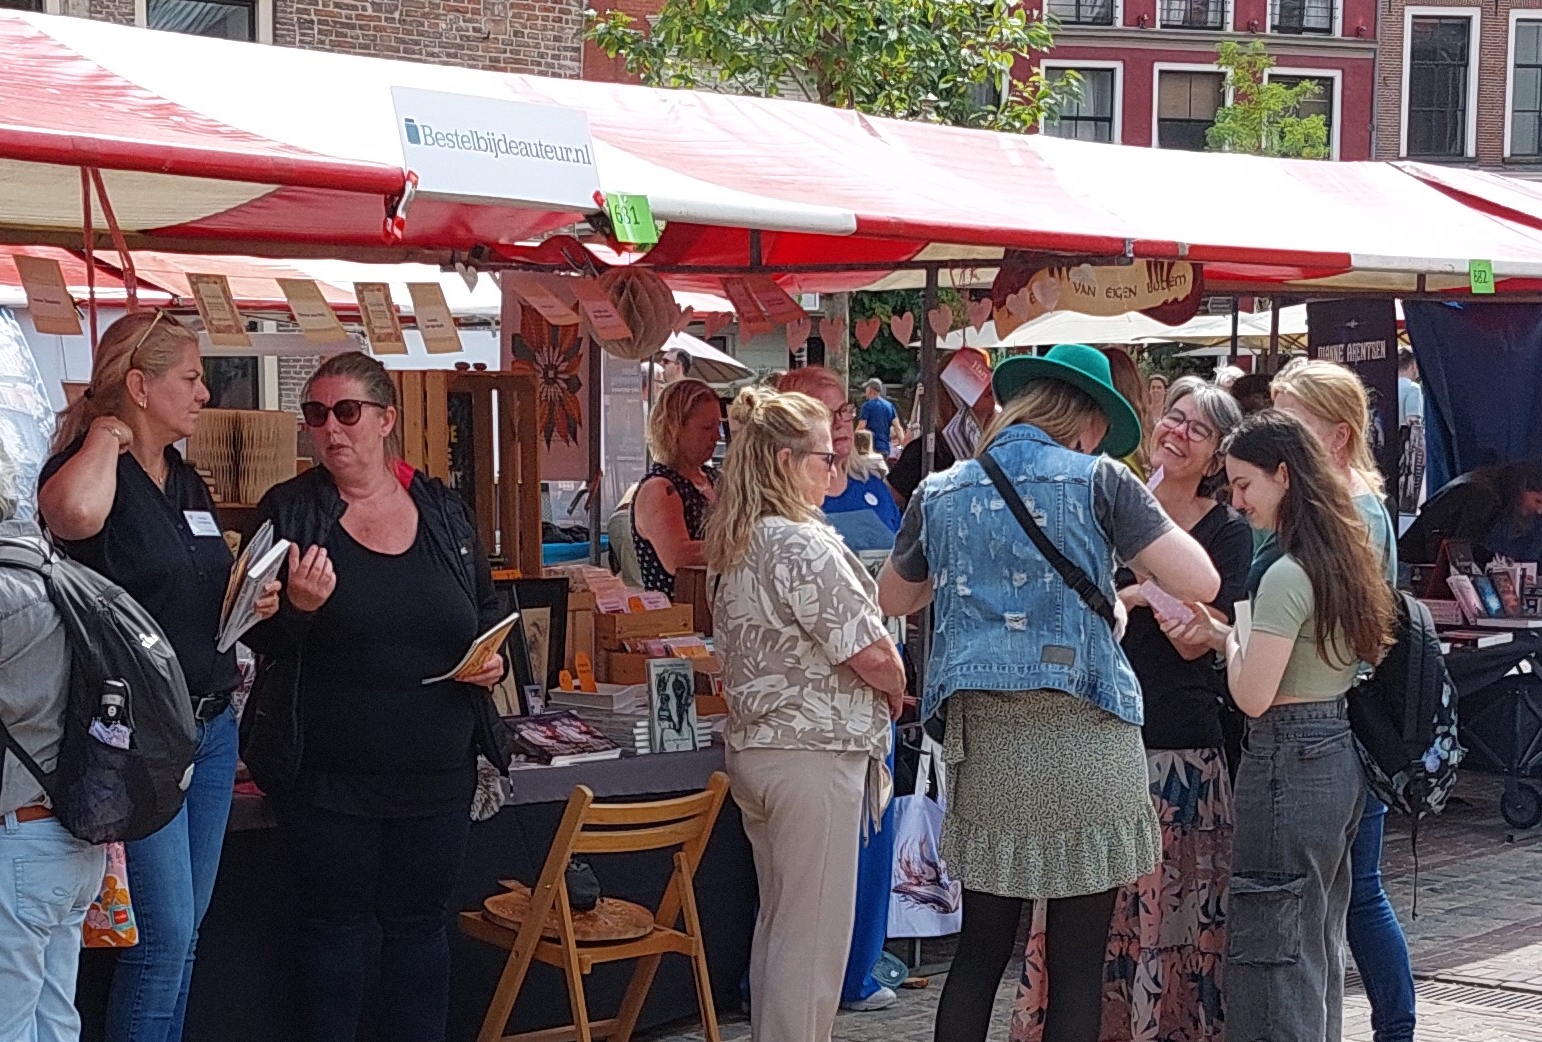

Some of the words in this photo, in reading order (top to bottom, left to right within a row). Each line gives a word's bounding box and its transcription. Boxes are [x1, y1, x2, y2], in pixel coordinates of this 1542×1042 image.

[420, 124, 592, 165] Bestelbijdeauteur.nl
[1072, 281, 1096, 298] VAN
[1106, 285, 1138, 301] EIGEN
